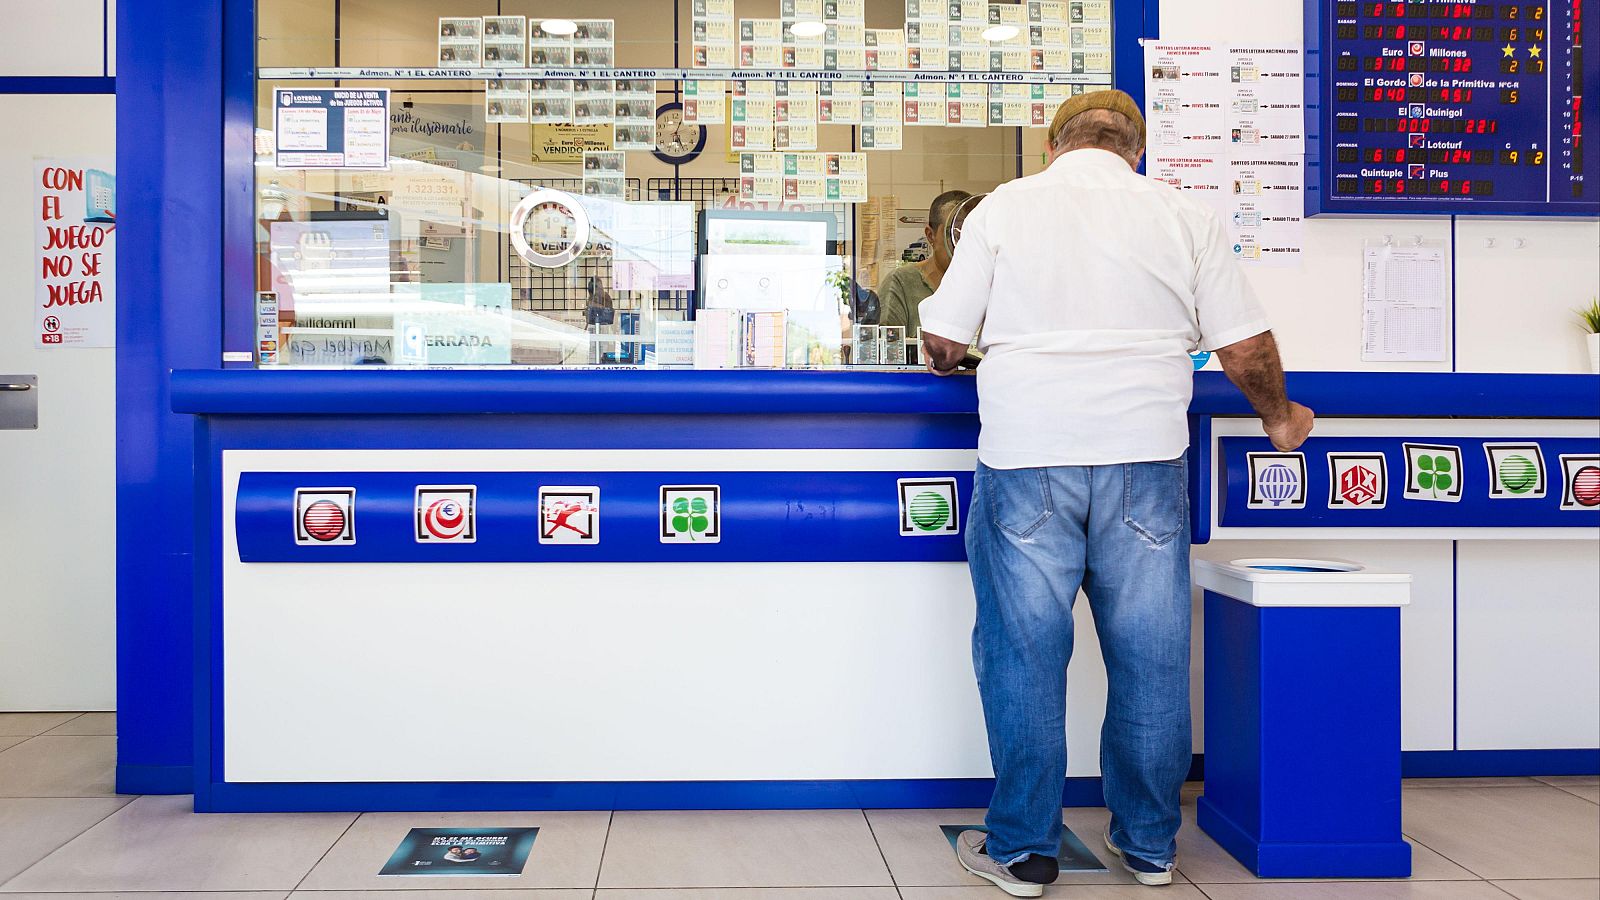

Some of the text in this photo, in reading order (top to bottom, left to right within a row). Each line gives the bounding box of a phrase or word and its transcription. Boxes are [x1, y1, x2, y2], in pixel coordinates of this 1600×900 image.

[1509, 7, 1543, 19] 2 2
[1509, 29, 1517, 40] 6
[1535, 29, 1543, 40] 4
[1382, 48, 1467, 57] Euro Millones
[1509, 60, 1544, 72] 2 7
[1364, 78, 1374, 86] El
[1377, 78, 1406, 87] Gordo
[1425, 79, 1438, 87] de
[1452, 80, 1495, 88] Primitiva
[1509, 91, 1517, 103] 5
[1398, 107, 1463, 118] El Quinigol
[410, 118, 473, 136] ilusionarte
[1427, 141, 1463, 149] Lototurf
[1509, 151, 1518, 163] 9
[1534, 151, 1543, 164] 2
[42, 167, 83, 191] CON
[1361, 169, 1449, 178] Quintuple Plus
[42, 196, 64, 221] EL
[42, 225, 105, 251] JUEGO
[42, 252, 102, 280] NO SE
[42, 280, 103, 309] JUEGA
[44, 334, 61, 343] +18
[424, 335, 492, 347] ERRADA
